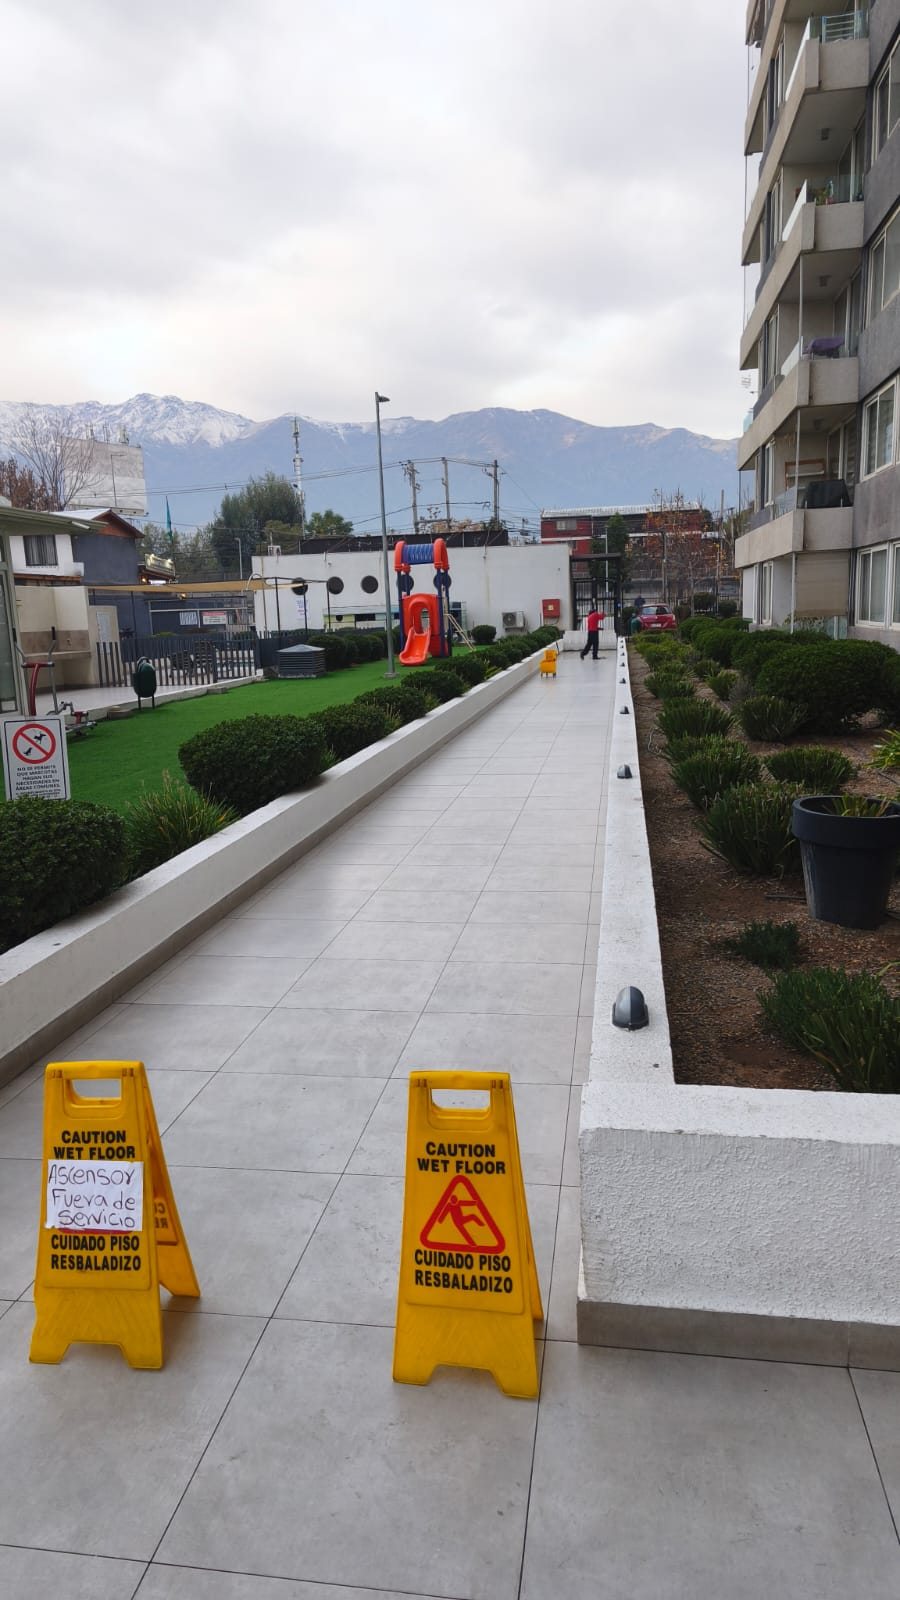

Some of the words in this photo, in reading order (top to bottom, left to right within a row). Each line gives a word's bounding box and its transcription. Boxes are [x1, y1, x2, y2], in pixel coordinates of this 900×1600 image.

[61, 1130, 126, 1144] CAUTION
[54, 1146, 84, 1160] WET
[89, 1145, 136, 1159] FLOOR
[425, 1142, 496, 1157] CAUTION
[48, 1164, 135, 1185] Ascensor
[417, 1158, 450, 1173] WET
[456, 1160, 505, 1174] FLOOR
[52, 1188, 108, 1208] Fuera
[113, 1190, 136, 1210] de
[51, 1234, 106, 1252] CUIDADO
[110, 1235, 140, 1251] PISO
[51, 1254, 141, 1271] RESBALADIZO
[414, 1249, 474, 1270] CUIDADO
[479, 1256, 511, 1272] PISO
[415, 1270, 513, 1293] RESBALADIZO
